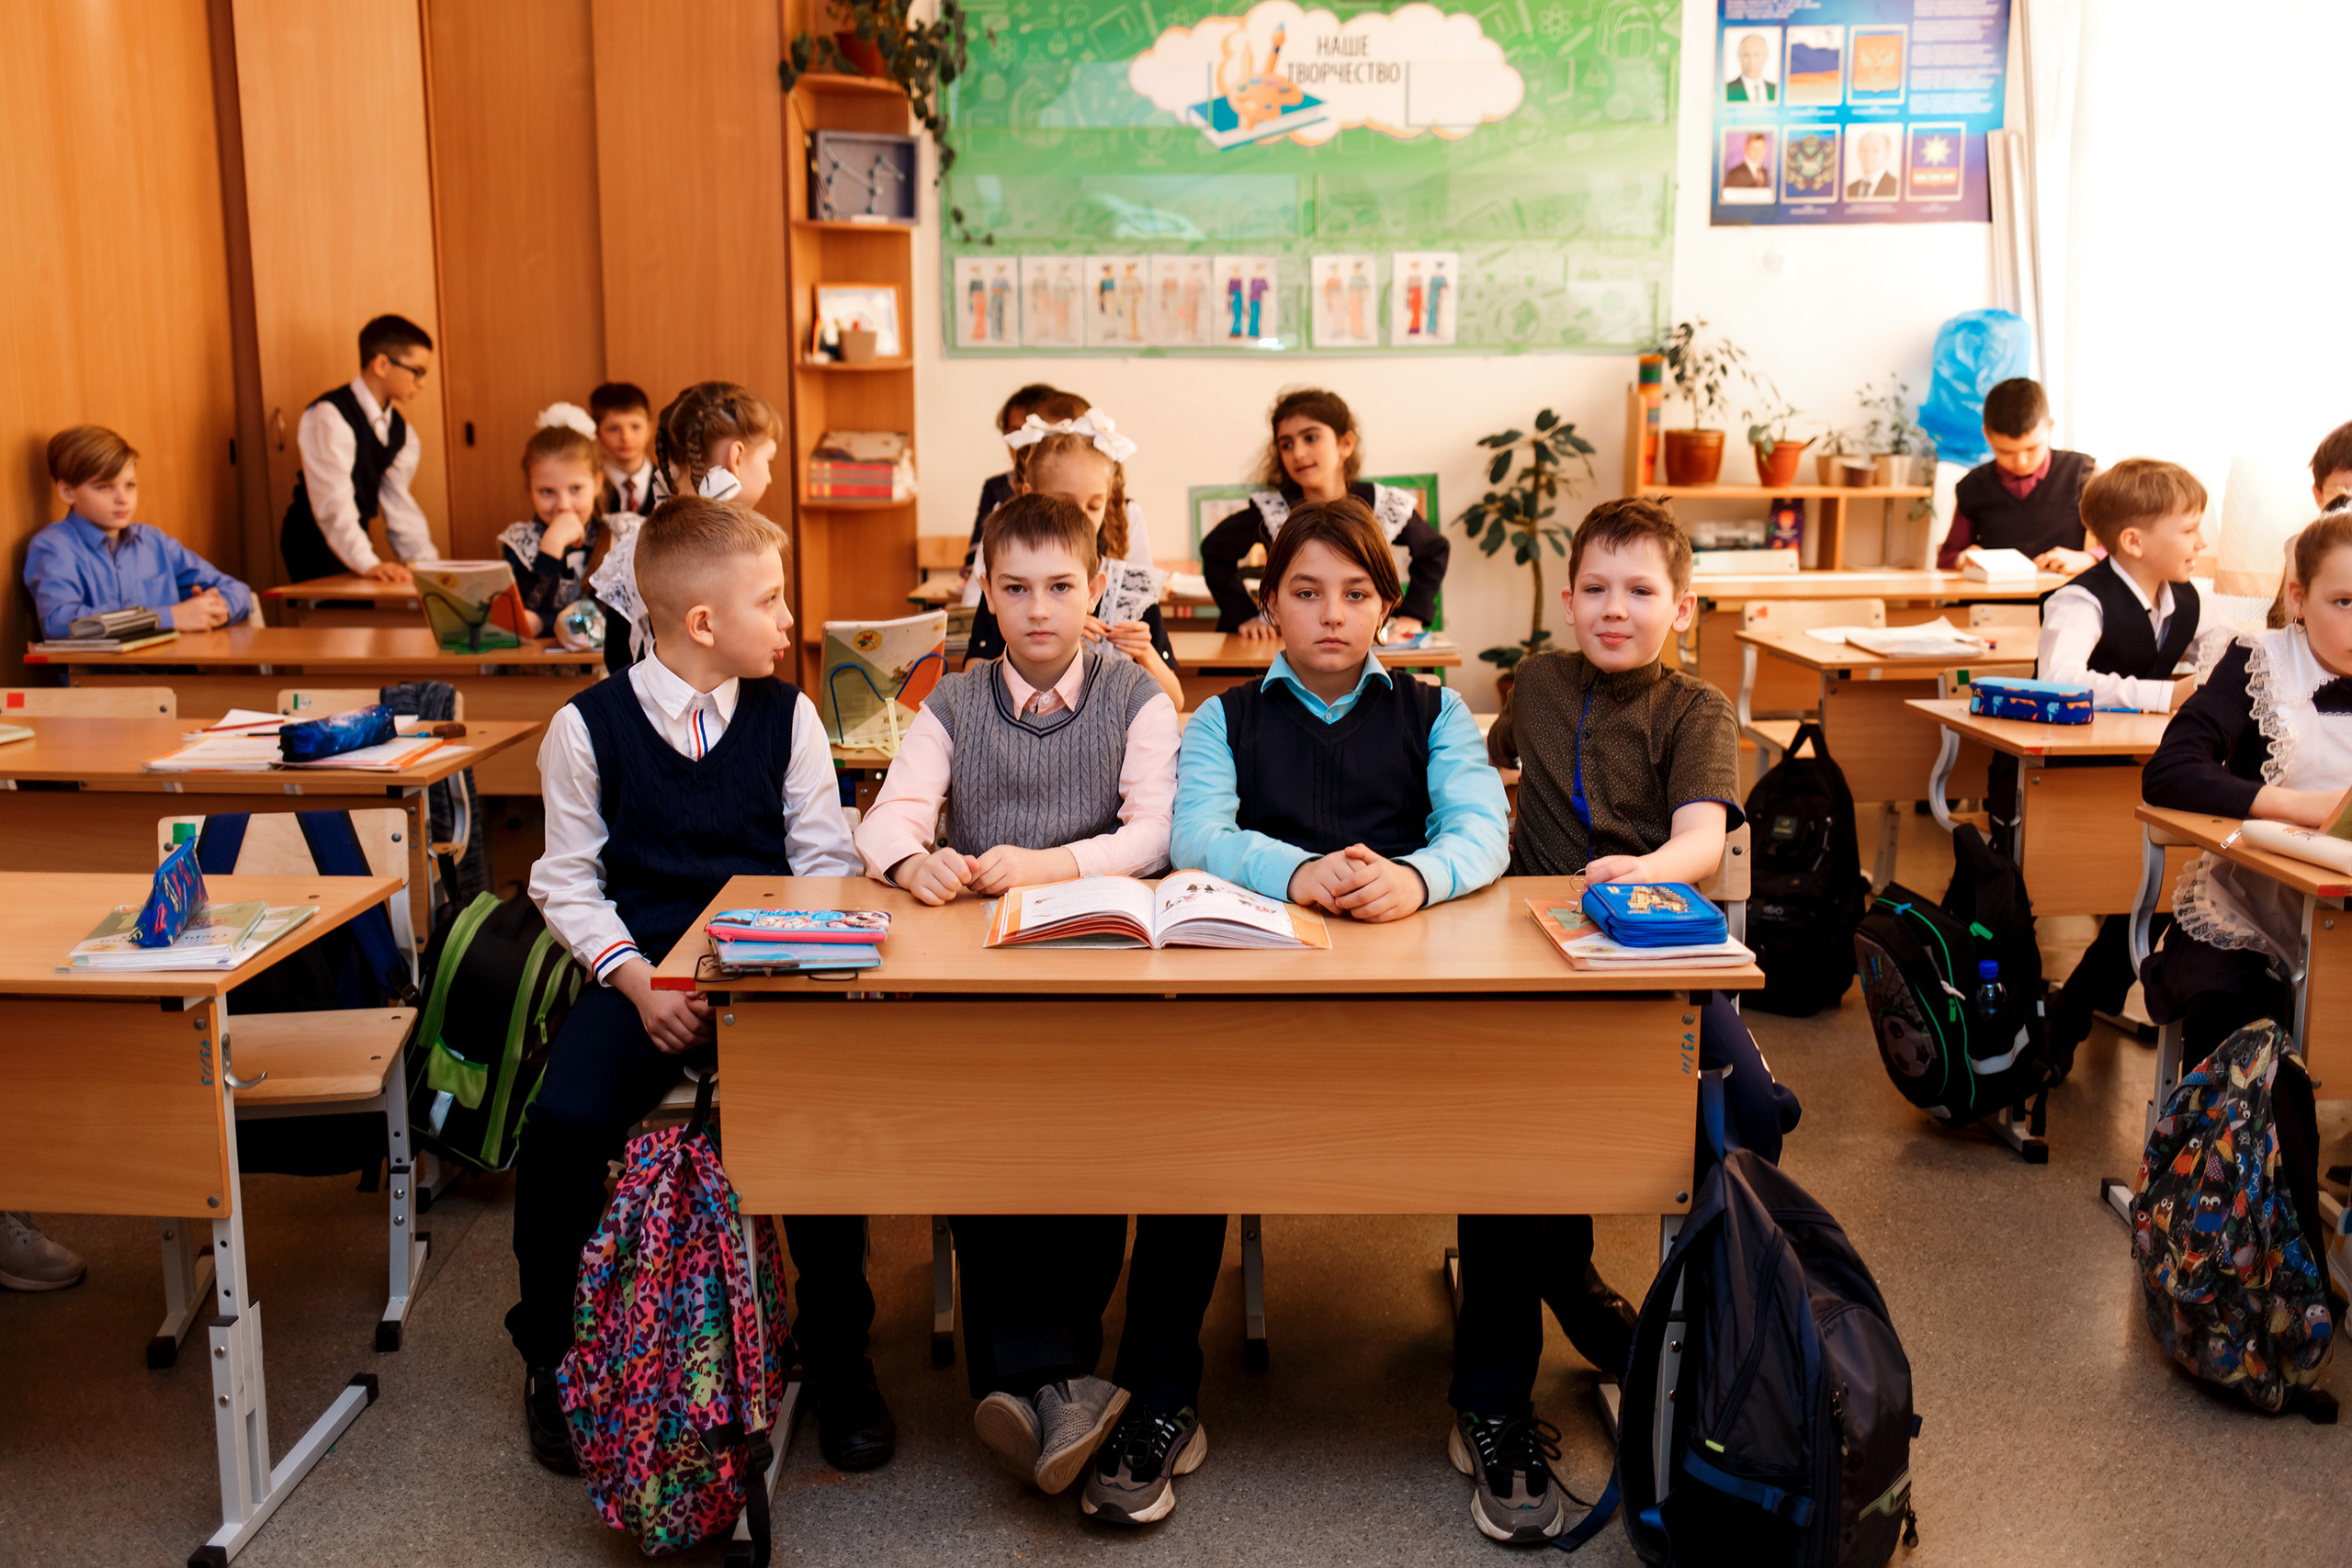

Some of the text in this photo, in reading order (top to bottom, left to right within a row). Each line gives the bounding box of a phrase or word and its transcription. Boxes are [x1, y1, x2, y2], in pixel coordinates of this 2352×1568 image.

[1316, 35, 1370, 57] НАШЕ
[1287, 62, 1401, 85] ТВОРЧЕСТВО
[199, 1039, 212, 1086] 43/13
